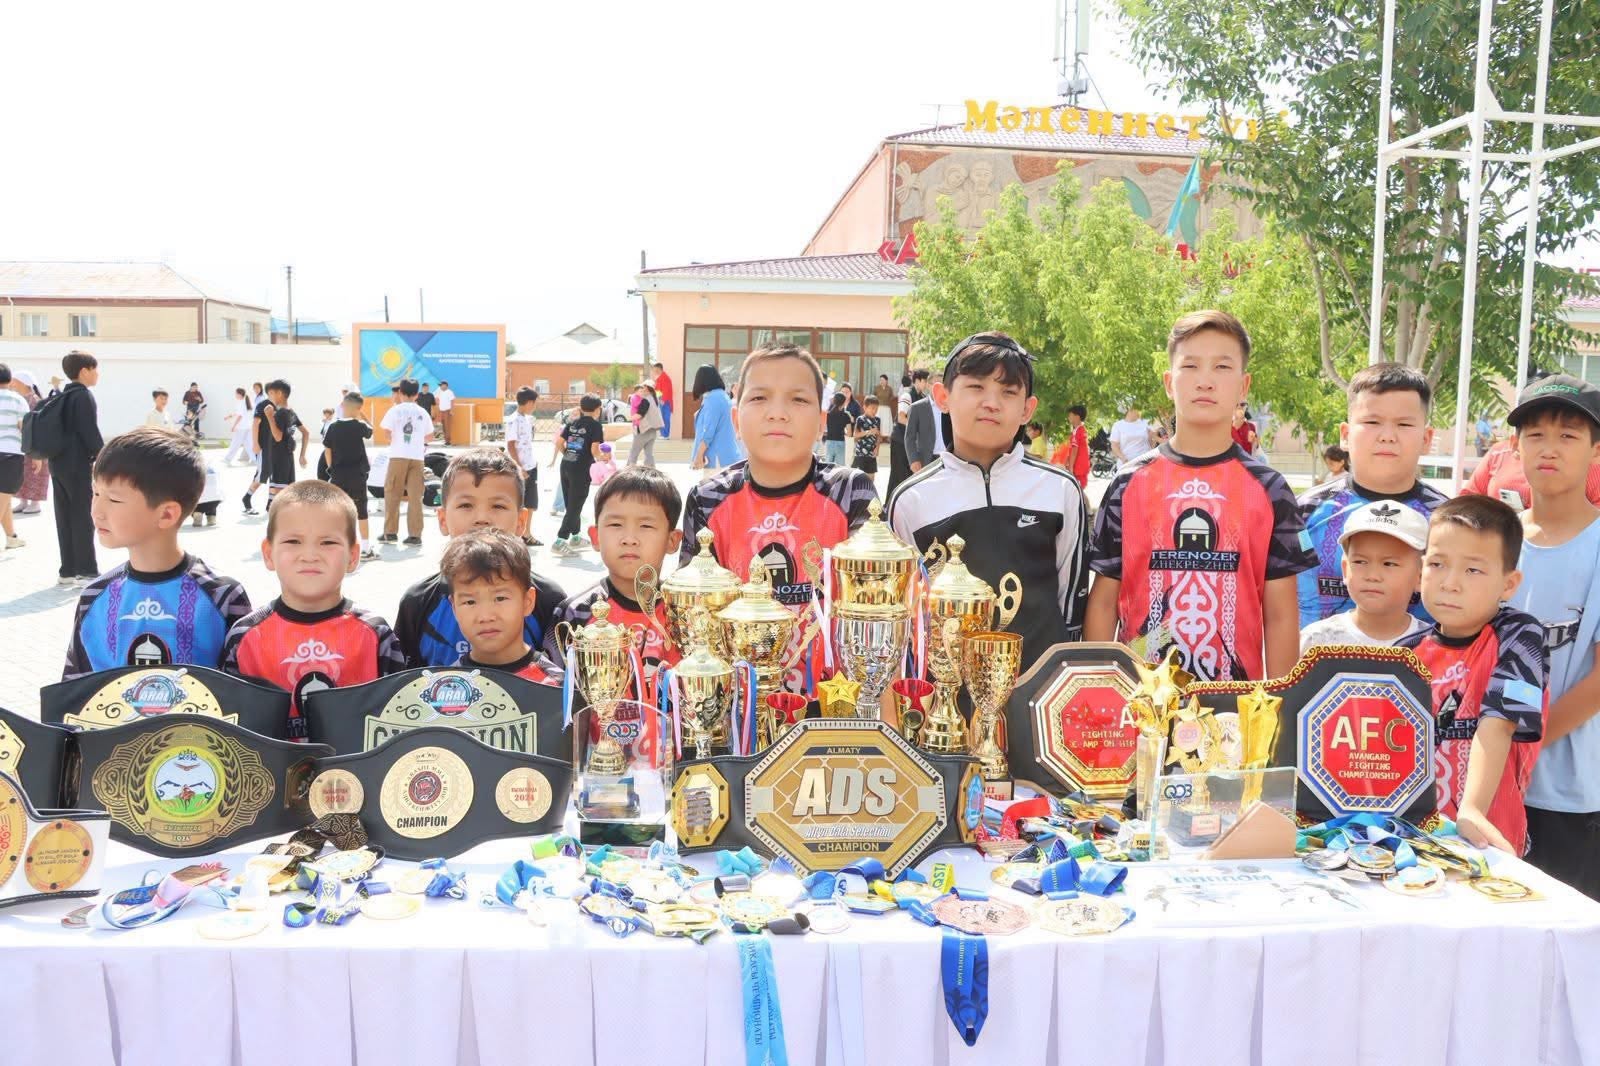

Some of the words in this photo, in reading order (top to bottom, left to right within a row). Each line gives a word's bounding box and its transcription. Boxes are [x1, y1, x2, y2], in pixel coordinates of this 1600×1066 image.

[1022, 514, 1037, 522] NIKE
[1151, 551, 1237, 562] TERENOZEK
[1081, 730, 1124, 739] FIGHTING
[1330, 715, 1407, 752] AFC
[1349, 752, 1391, 761] AVANGARD
[1349, 761, 1391, 770] FIGHTING
[1339, 771, 1401, 780] CHAMPIONSHIP
[792, 766, 897, 817] ADS
[396, 816, 448, 829] CHAMPION
[849, 826, 892, 838] Selection
[817, 842, 880, 852] CHAMPION
